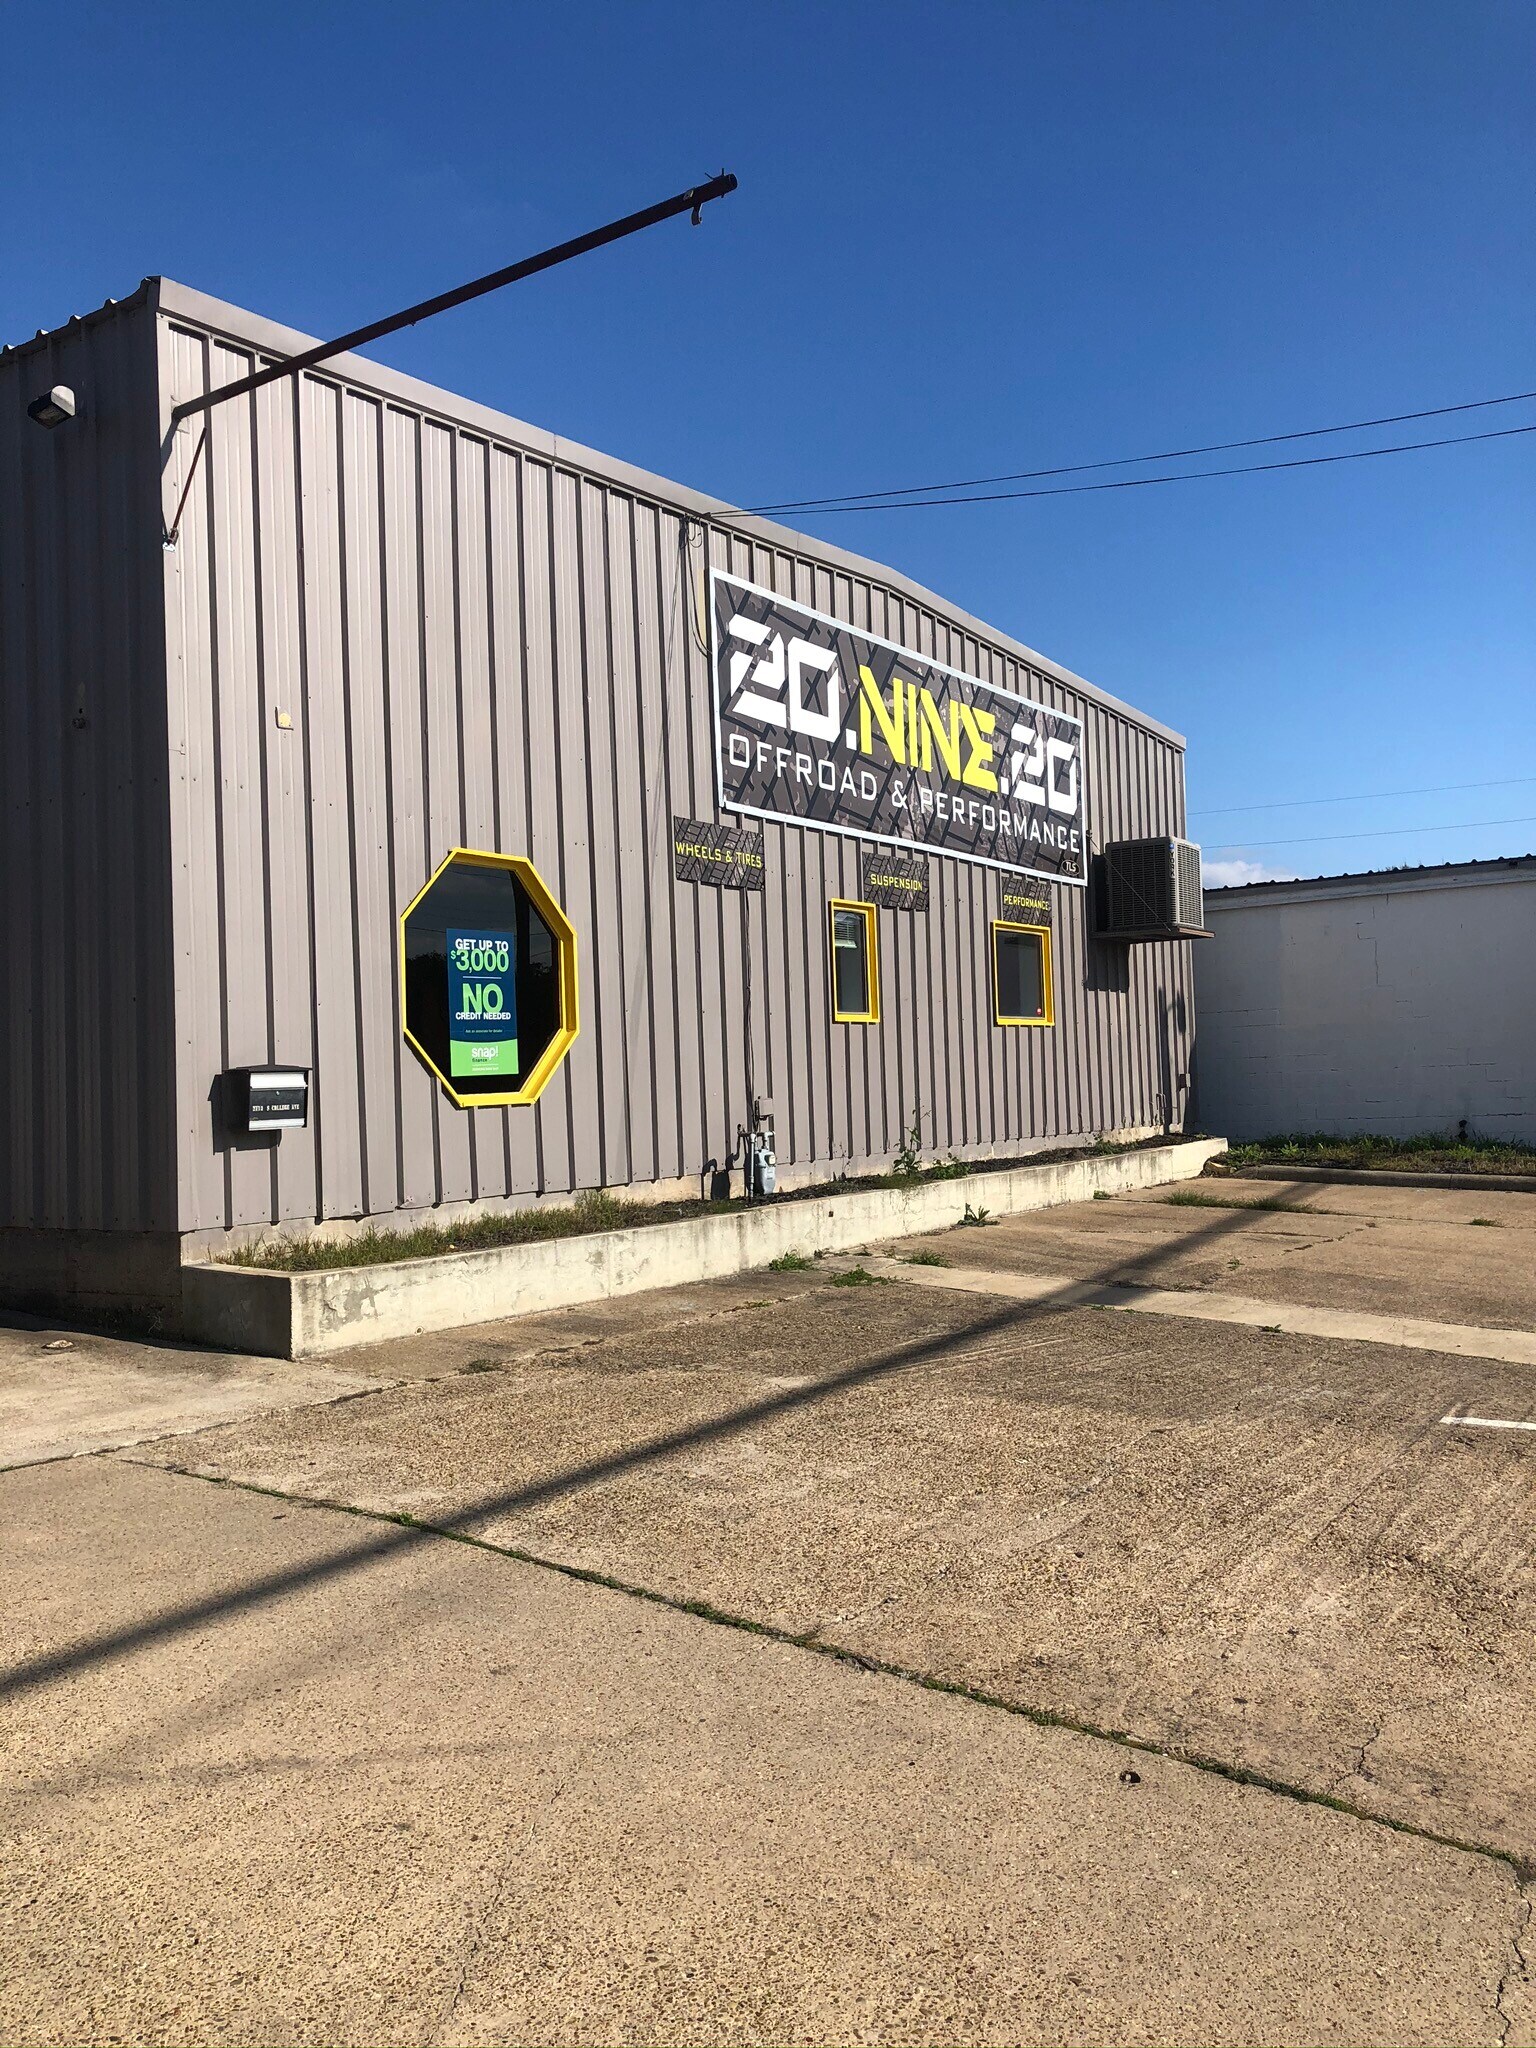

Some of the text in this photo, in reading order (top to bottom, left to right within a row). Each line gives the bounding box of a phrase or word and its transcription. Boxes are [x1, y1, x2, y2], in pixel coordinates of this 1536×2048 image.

[728, 733, 1080, 854] OFFROAD & PERFORMANCE
[675, 841, 762, 868] WHEELS & TIRES
[1065, 861, 1077, 872] TLS
[870, 873, 923, 891] SUSPENSION
[1003, 894, 1050, 911] PERFORMANCE
[455, 938, 509, 952] GET UP TO
[450, 948, 509, 973] $3,000
[462, 983, 504, 1014] NO
[455, 1012, 512, 1020] CREDIT NEEDED
[471, 1045, 498, 1060] snap!
